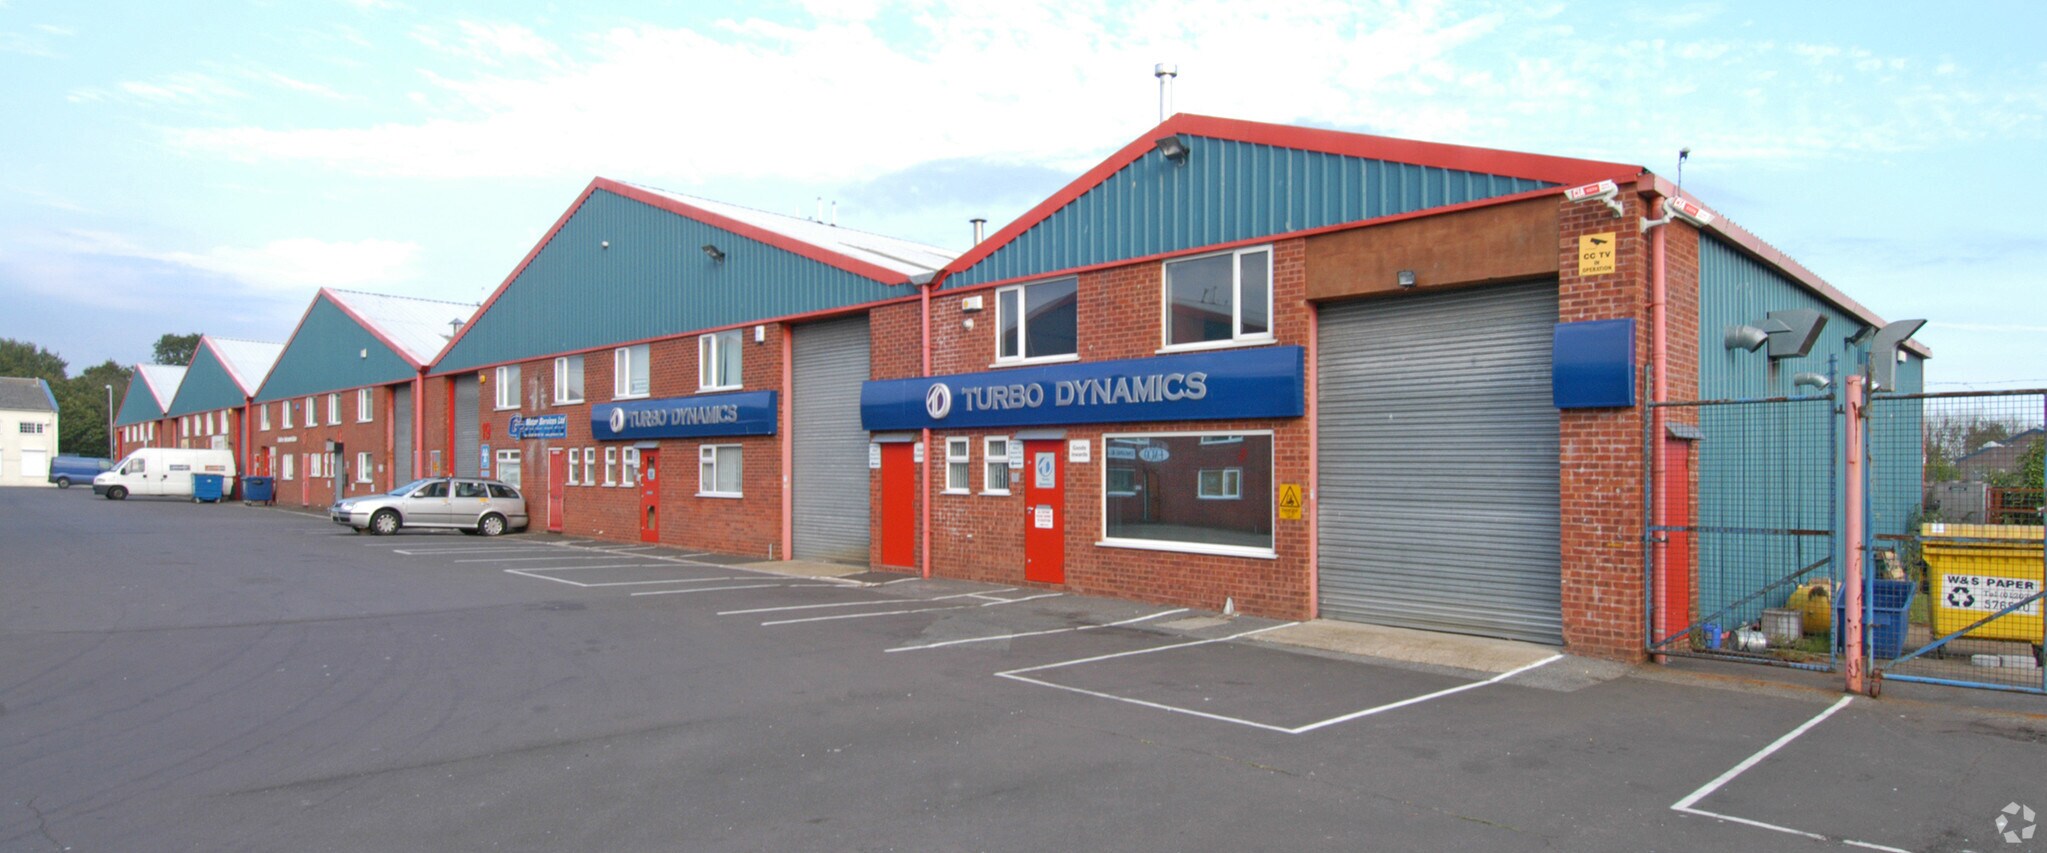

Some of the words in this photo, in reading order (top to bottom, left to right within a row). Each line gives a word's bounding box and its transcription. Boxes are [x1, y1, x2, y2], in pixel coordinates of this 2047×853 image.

[1582, 265, 1612, 273] OPERATION
[961, 383, 1044, 412] TURBO
[1055, 371, 1208, 406] DYNAMICS
[629, 409, 667, 428] TURBO
[671, 404, 738, 426] DYNAMICS
[1947, 575, 1980, 586] W&S
[1986, 578, 2035, 590] PAPER
